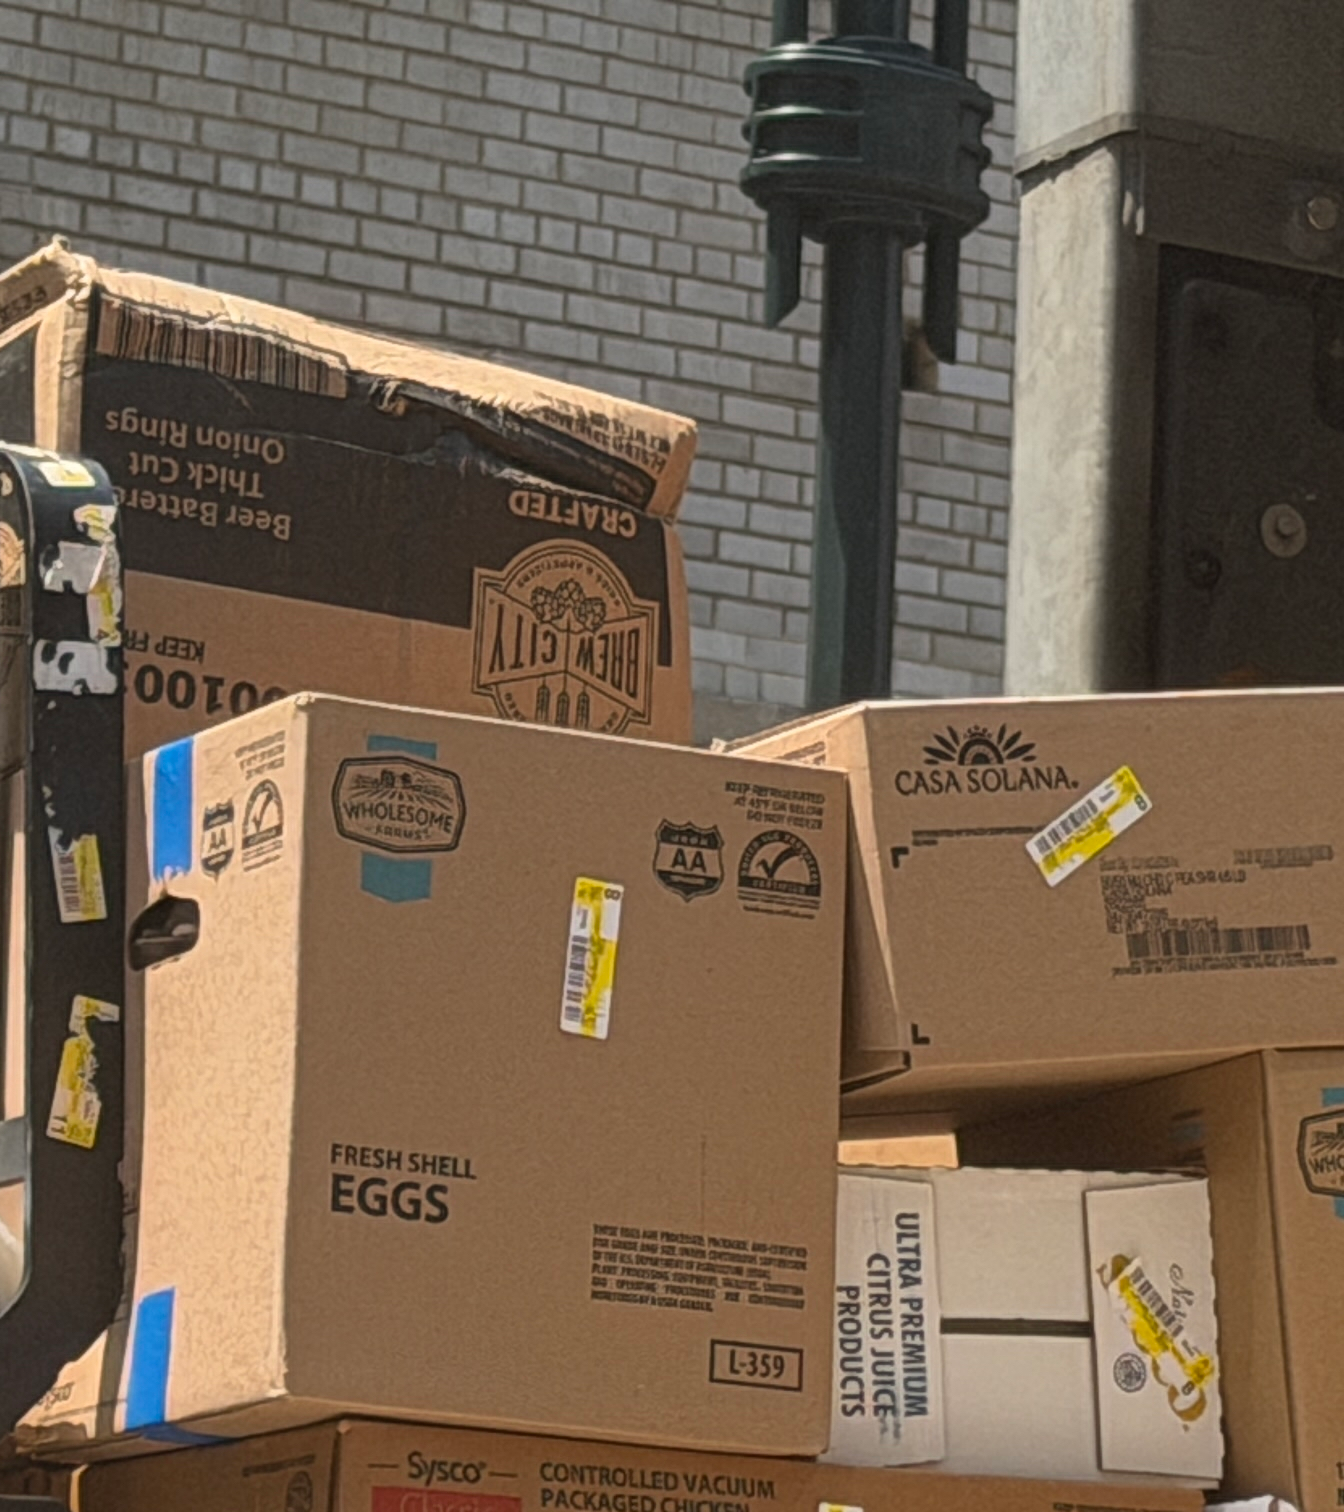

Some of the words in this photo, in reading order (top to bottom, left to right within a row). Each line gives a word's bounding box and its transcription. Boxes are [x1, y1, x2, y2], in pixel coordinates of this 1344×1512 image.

[106, 408, 188, 449] Rings
[195, 426, 286, 465] Onion
[128, 452, 181, 485] Cut
[188, 462, 265, 499] Thick
[225, 509, 292, 542] Beer
[508, 489, 638, 538] CRAFTED
[155, 636, 205, 664] KEEP
[488, 603, 557, 675] CITY
[575, 627, 641, 699] BREW
[895, 767, 962, 796] CASA
[967, 765, 1072, 793] SOLANA
[344, 801, 455, 834] WHOLESOME
[671, 847, 707, 873] AA
[331, 1143, 403, 1171] FRESH
[407, 1147, 478, 1181] SHELL
[331, 1174, 450, 1225] EGGS
[894, 1212, 921, 1290] ULTRA
[866, 1252, 893, 1341] CITRUS
[728, 1347, 786, 1380] L-359
[836, 1284, 866, 1419] PRODUCTS
[899, 1296, 929, 1418] PREMIUM
[869, 1345, 897, 1418] JUICE
[407, 1450, 486, 1487] Sysco
[539, 1461, 679, 1492] CONTROLLED
[682, 1471, 775, 1500] VACUUM
